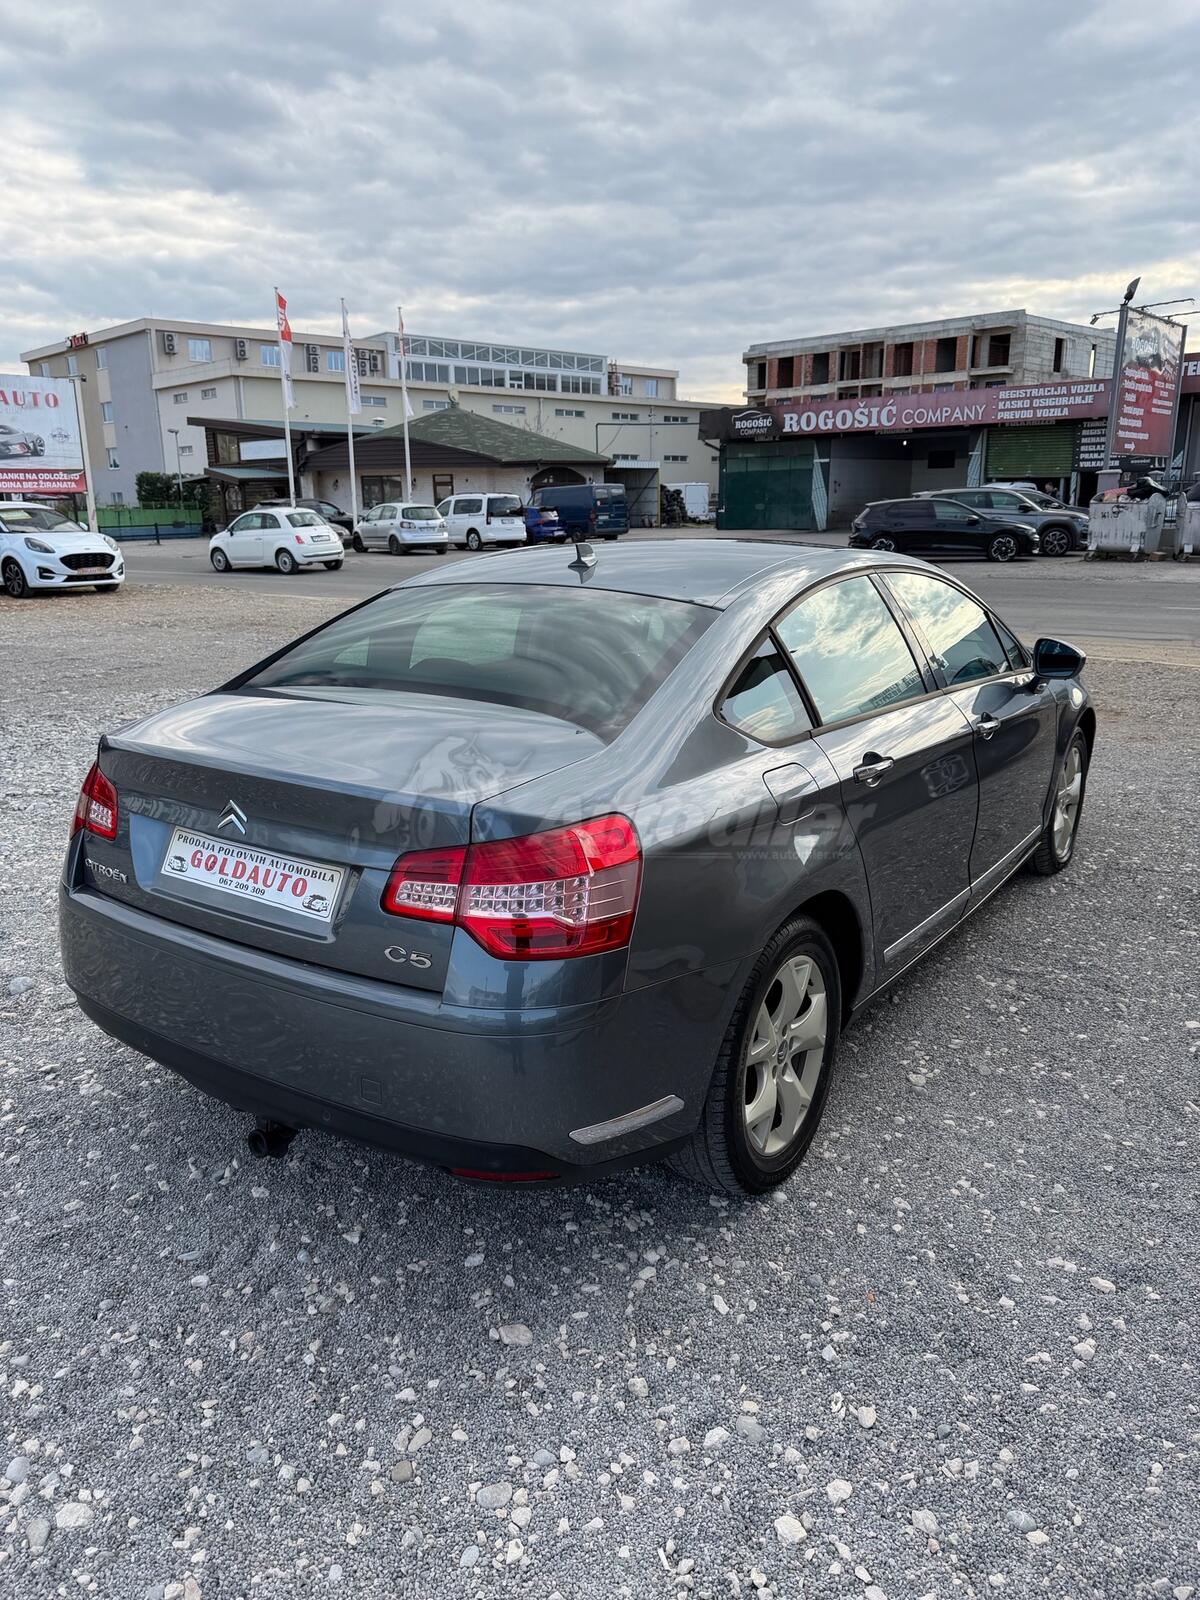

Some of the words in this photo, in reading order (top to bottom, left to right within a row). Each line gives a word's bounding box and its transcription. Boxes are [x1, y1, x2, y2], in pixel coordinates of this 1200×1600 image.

[0, 389, 59, 408] AUTO
[999, 386, 1067, 399] REGISTRACIJA
[1070, 383, 1105, 394] VOZILA
[998, 399, 1030, 410] KASKO
[1033, 395, 1094, 408] OSIGURANJE
[782, 399, 897, 433] ROGOŠIĆ
[901, 405, 986, 424] COMPANY
[997, 409, 1033, 420] PREVOD
[1036, 407, 1069, 418] VOZILA
[735, 416, 772, 429] ROGOŠIĆ
[740, 427, 768, 436] COMPANY
[25, 472, 37, 480] NA
[0, 481, 22, 489] DINA
[23, 481, 37, 489] BEZ
[177, 833, 216, 852] PRODAJA
[217, 846, 267, 865] POLOVNIH
[268, 858, 335, 883] AUTOMOBILA
[85, 858, 128, 884] CITROËN
[190, 849, 308, 898] GOLDAUTO
[218, 877, 233, 886] 067
[234, 881, 249, 891] 209
[250, 886, 266, 896] 309
[384, 945, 432, 969] C5
